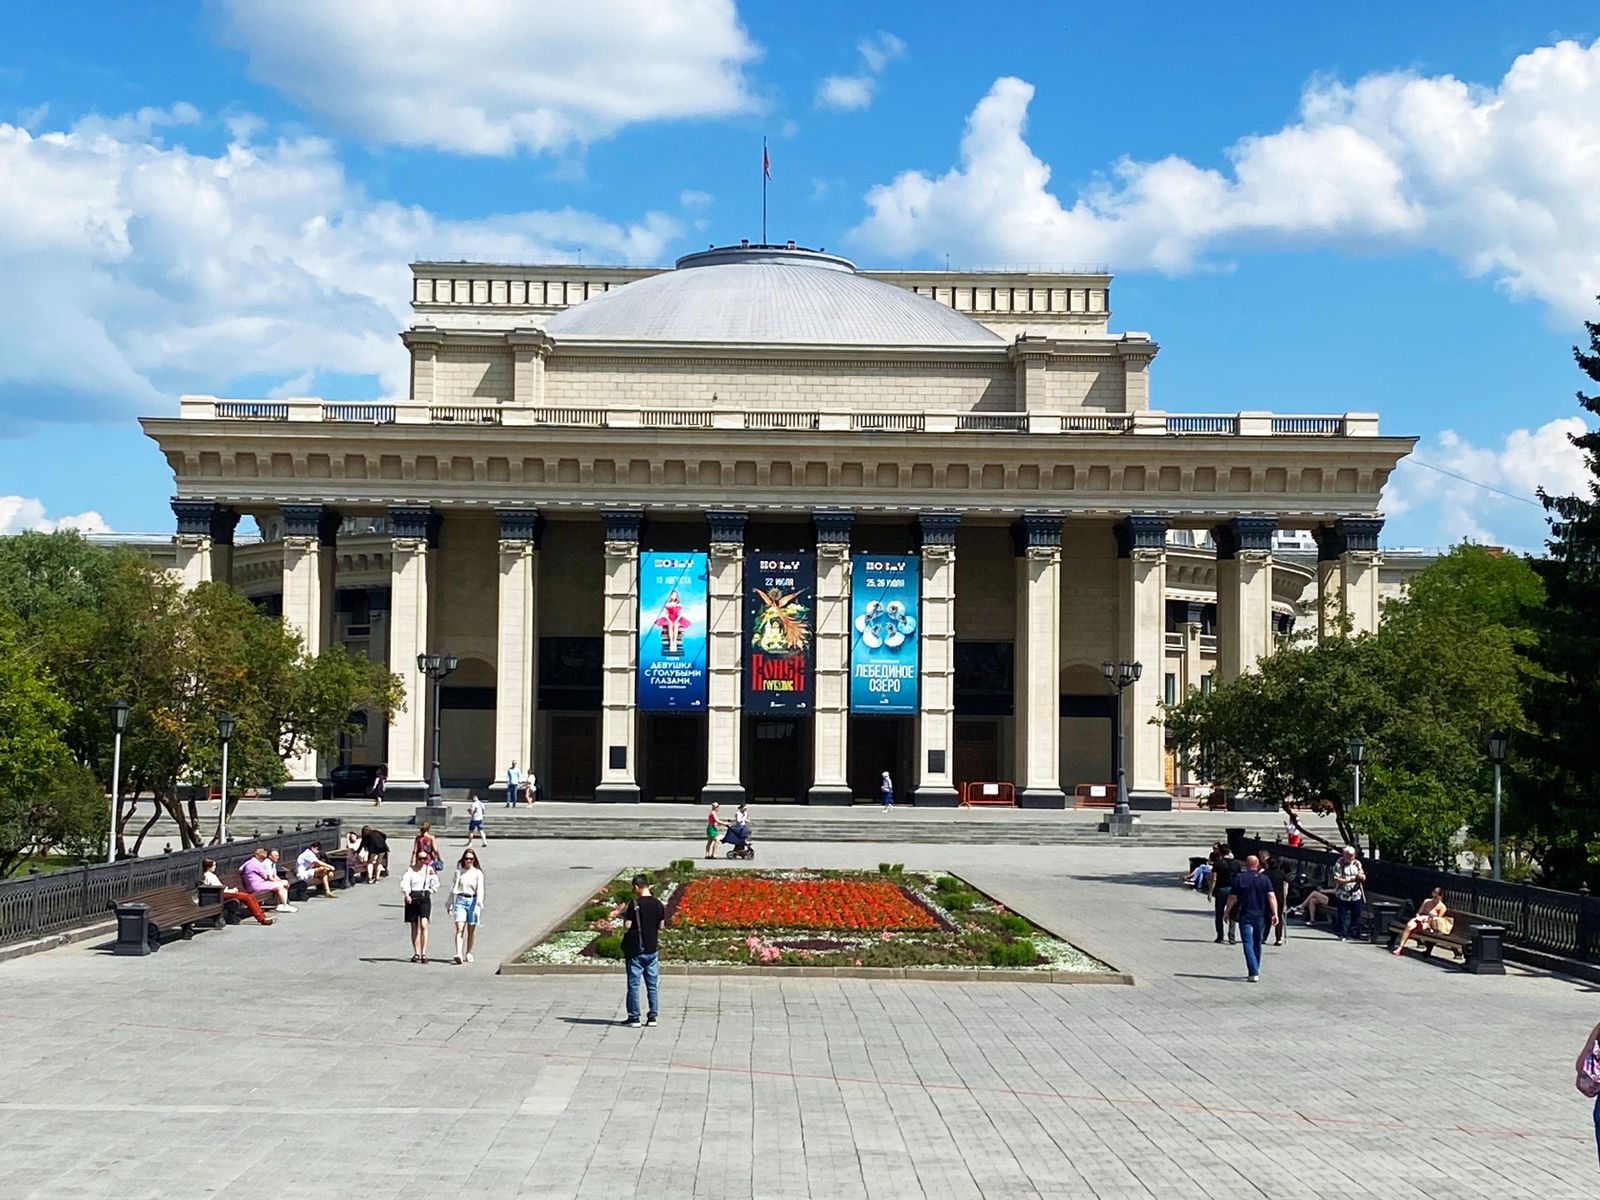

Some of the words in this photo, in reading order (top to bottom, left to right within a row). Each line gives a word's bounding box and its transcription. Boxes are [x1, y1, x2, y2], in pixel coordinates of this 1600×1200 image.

[765, 577, 774, 586] 22
[650, 661, 693, 669] ДЕВУШКА
[644, 669, 652, 677] С
[653, 669, 702, 677] ГОЛУБЫМИ
[855, 663, 914, 679] ЛЕБЕДИНОЕ
[650, 677, 693, 686] ГЛАЗАМИ,
[869, 678, 901, 693] ОЗЕРО
